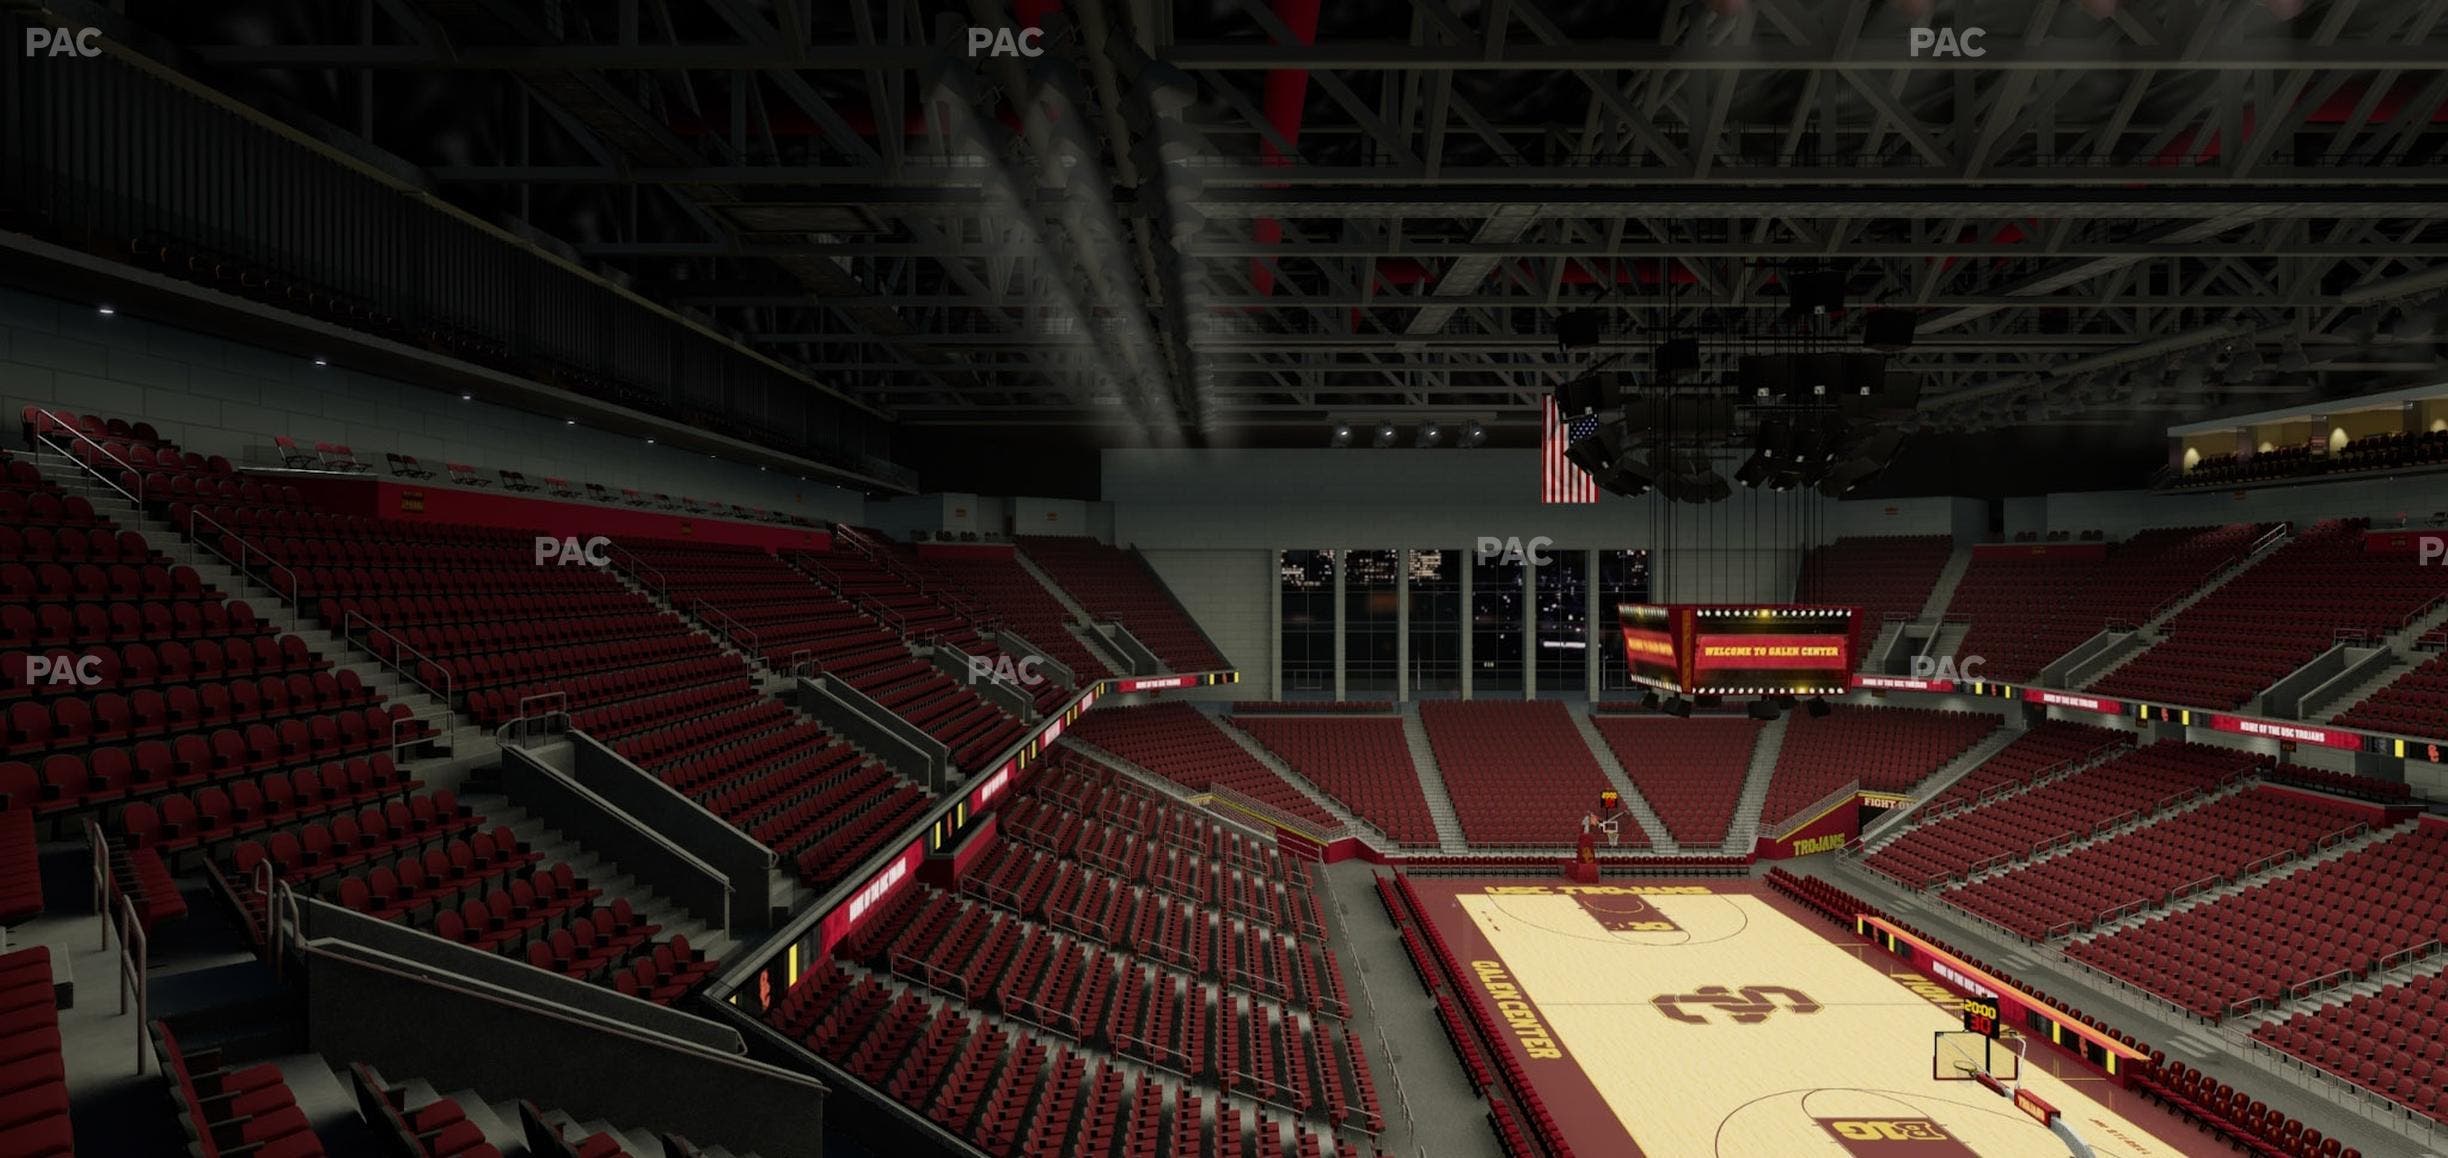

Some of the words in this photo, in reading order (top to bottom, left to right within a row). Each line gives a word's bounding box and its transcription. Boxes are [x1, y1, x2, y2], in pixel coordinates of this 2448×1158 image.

[1705, 646, 1752, 657] WELCOME
[1754, 647, 1767, 657] TO
[1801, 647, 1839, 657] CENTER
[1864, 797, 1896, 809] FIGHT
[1792, 832, 1846, 856] TROJANS
[1471, 960, 1522, 1000] GALEN
[1497, 1001, 1562, 1059] CENTER
[1964, 999, 1997, 1020] 20:00
[1970, 1014, 1991, 1036] 30
